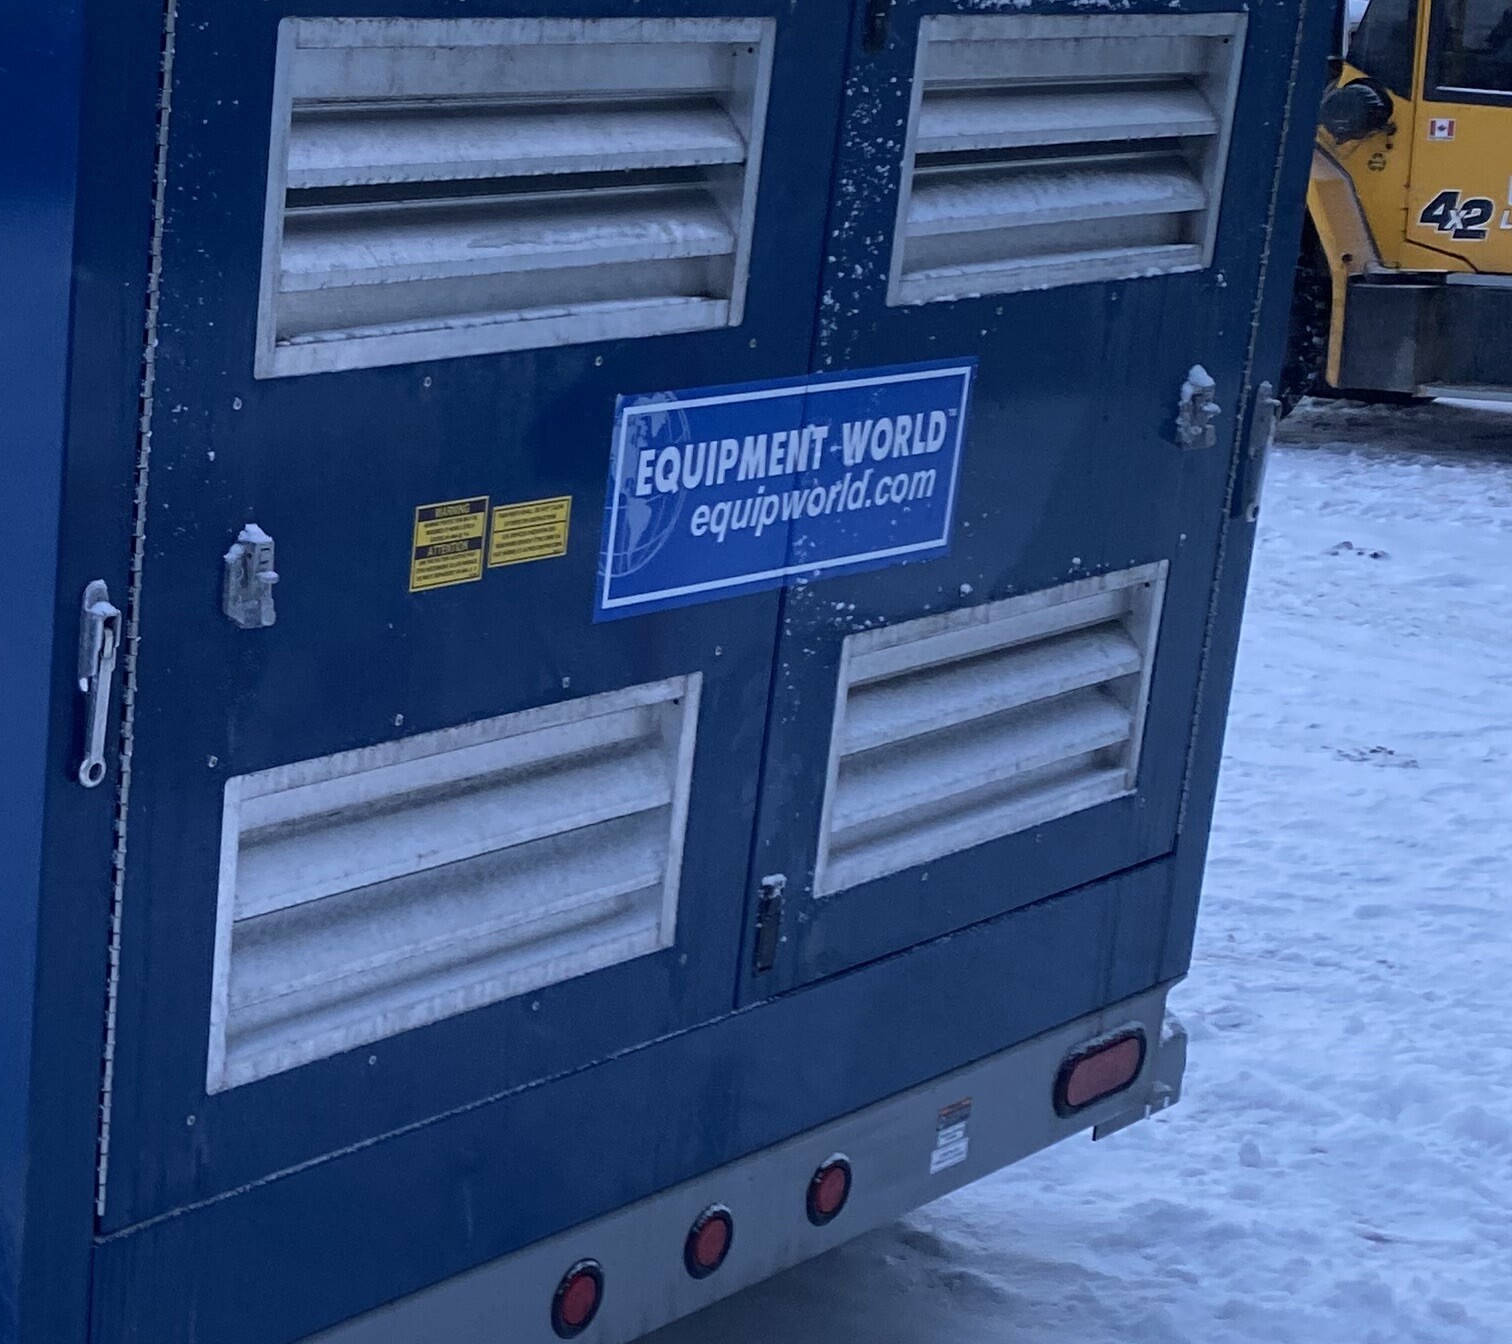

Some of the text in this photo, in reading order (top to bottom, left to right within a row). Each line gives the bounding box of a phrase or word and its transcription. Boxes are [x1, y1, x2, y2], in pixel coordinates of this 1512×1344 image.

[635, 409, 948, 497] EQUIPMENT WORLD
[690, 468, 937, 543] equipworld.com
